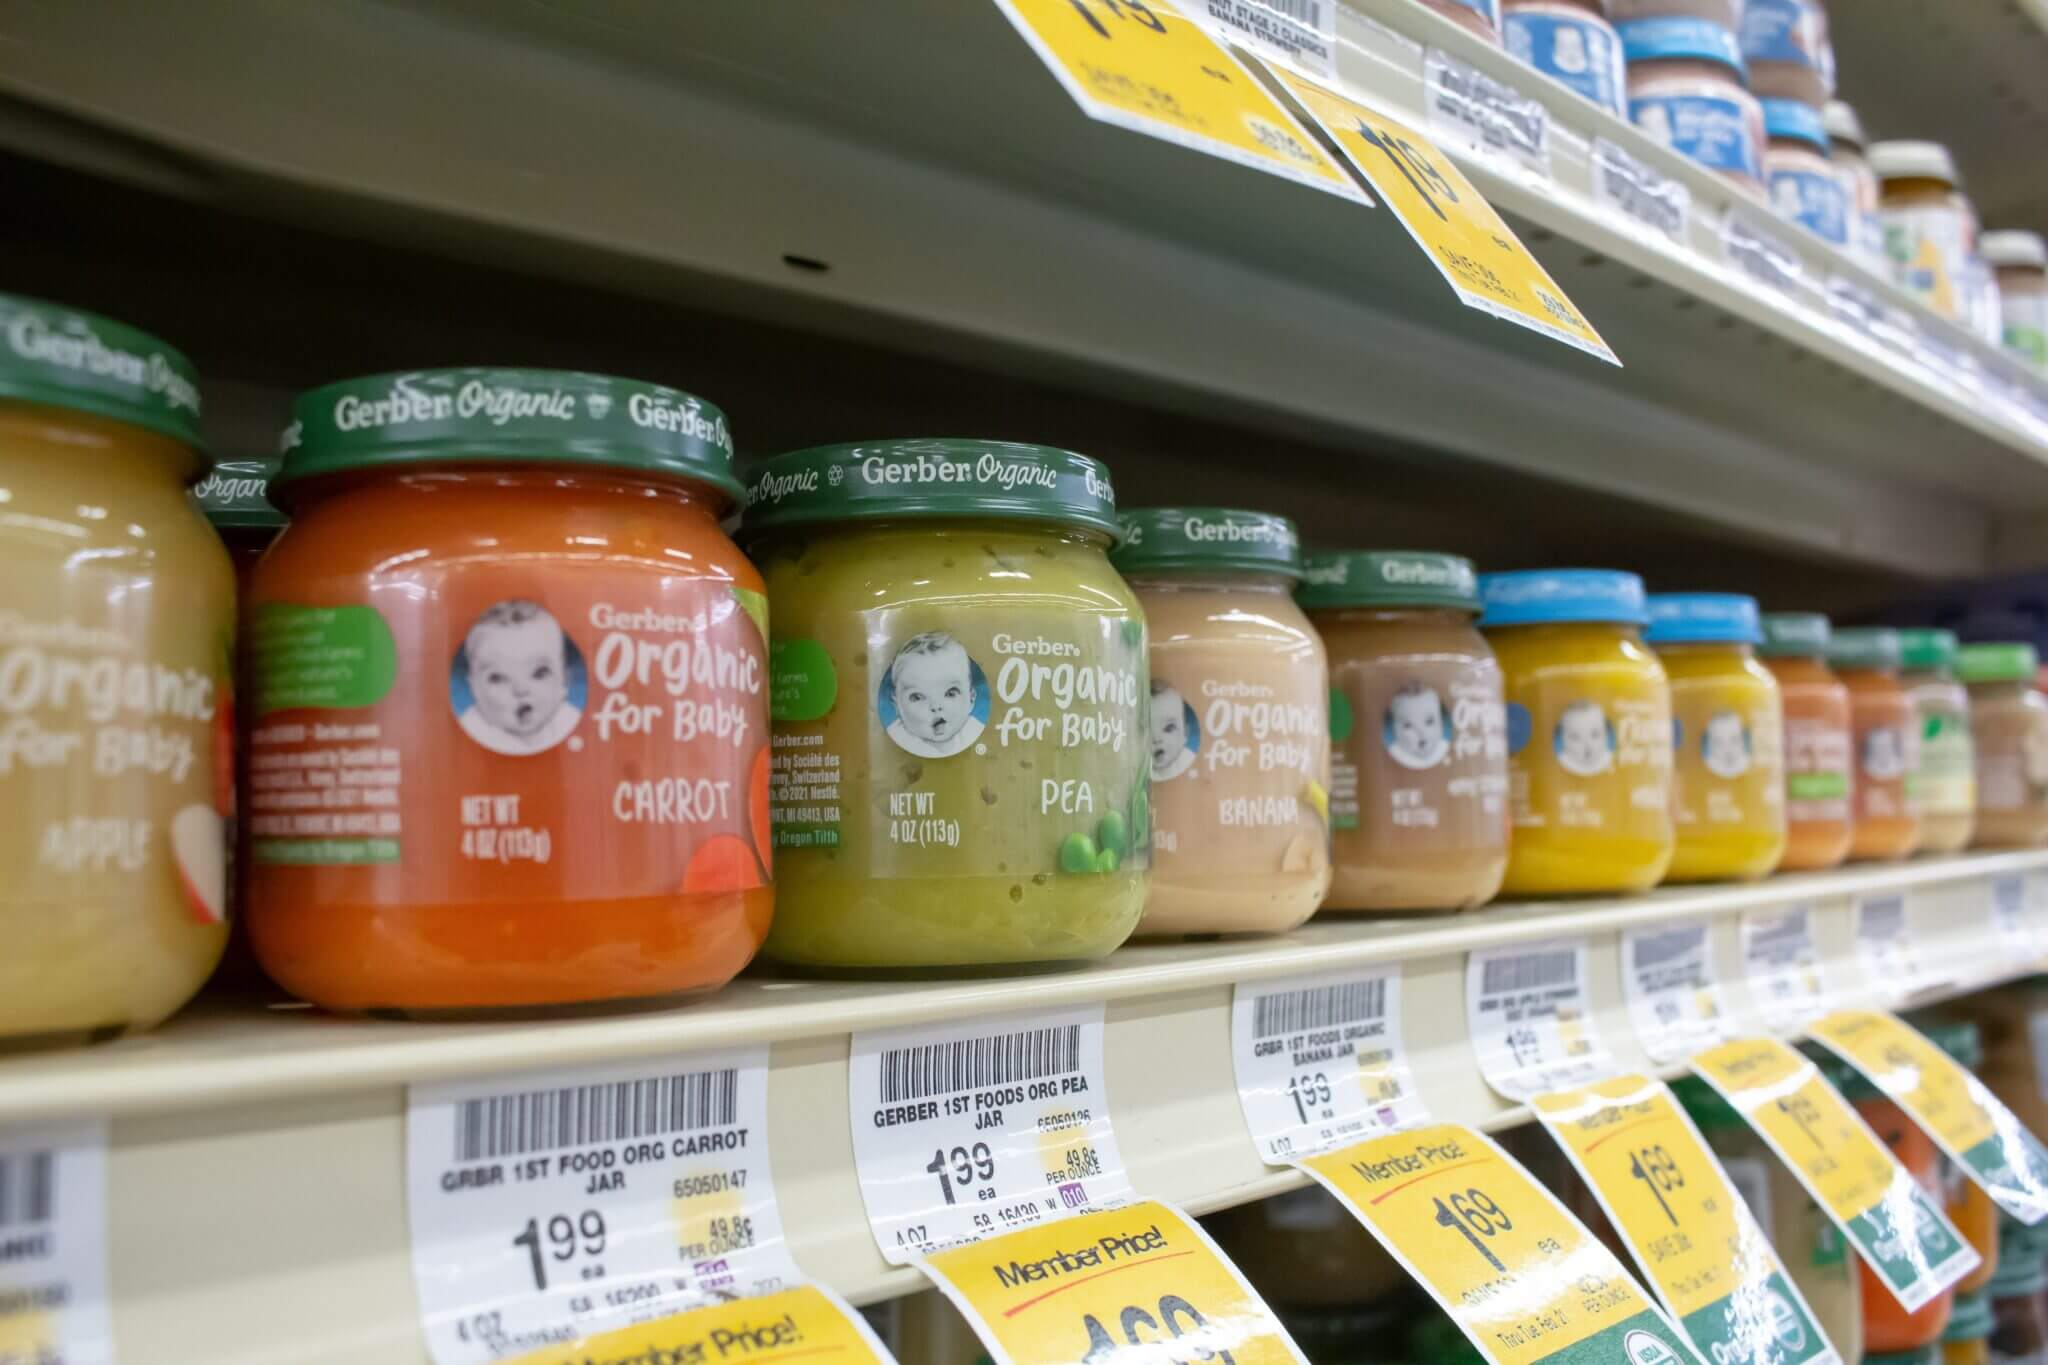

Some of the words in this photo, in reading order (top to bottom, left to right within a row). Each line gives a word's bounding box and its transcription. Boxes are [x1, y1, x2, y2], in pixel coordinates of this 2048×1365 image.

[1208, 4, 1250, 33] BANANA
[1236, 4, 1270, 31] STAGE
[1271, 22, 1280, 35] 2
[1281, 27, 1328, 59] CLASSICS
[335, 390, 451, 432] Gerber
[457, 380, 576, 427] Organic
[629, 392, 715, 443] Gerber
[760, 467, 819, 504] Organic
[862, 456, 970, 486] Gerber
[976, 453, 1057, 489] Organic
[589, 602, 698, 633] Gerber
[596, 633, 760, 695] Organic
[992, 633, 1081, 658] Gerber
[997, 657, 1138, 709] Organic
[593, 694, 662, 740] for
[673, 699, 749, 746] Baby
[995, 708, 1052, 747] for
[1062, 711, 1127, 752] Baby
[1205, 699, 1321, 741] Organic
[1205, 738, 1251, 772] for
[1259, 741, 1313, 775] Baby
[613, 781, 731, 825] CARROT
[824, 805, 841, 822] USA
[890, 792, 914, 817] NET
[916, 791, 936, 815] WT
[1041, 779, 1095, 815] PEA
[815, 829, 839, 845] Tilth
[890, 821, 900, 844] 4
[901, 820, 918, 844] OZ
[919, 817, 960, 848] (113g)
[1254, 1039, 1284, 1057] GRBR
[1287, 1035, 1305, 1050] 1ST
[1307, 1029, 1341, 1048] FOODS
[1343, 1021, 1386, 1041] ORGANIC
[1293, 1047, 1333, 1067] BANANA
[1336, 1042, 1355, 1058] JAR
[873, 1101, 939, 1128] GERBER
[943, 1095, 971, 1117] 1ST
[975, 1086, 1026, 1111] FOODS
[1027, 1079, 1058, 1101] ORG
[1061, 1075, 1089, 1096] PEA
[1287, 1072, 1332, 1125] 199
[975, 1109, 1005, 1131] JAR
[441, 1165, 504, 1193] GRBR
[513, 1157, 551, 1183] 1ST
[558, 1149, 616, 1175] FOOD
[623, 1140, 666, 1166] ORG
[671, 1128, 749, 1157] CARROT
[926, 1142, 995, 1206] 199
[1045, 1169, 1067, 1185] PER
[1067, 1160, 1102, 1181] OUNCE
[1351, 1146, 1421, 1185] Member
[585, 1170, 626, 1195] JAR
[673, 1169, 749, 1199] 65050147
[977, 1186, 997, 1203] ea
[1045, 1197, 1057, 1211] W
[1432, 1187, 1513, 1273] 169
[513, 1208, 607, 1291] 199
[678, 1244, 706, 1262] PER
[993, 1246, 1101, 1290] Member
[1099, 1224, 1169, 1263] Price!
[581, 1264, 605, 1281] ea
[709, 1312, 804, 1358] Price!
